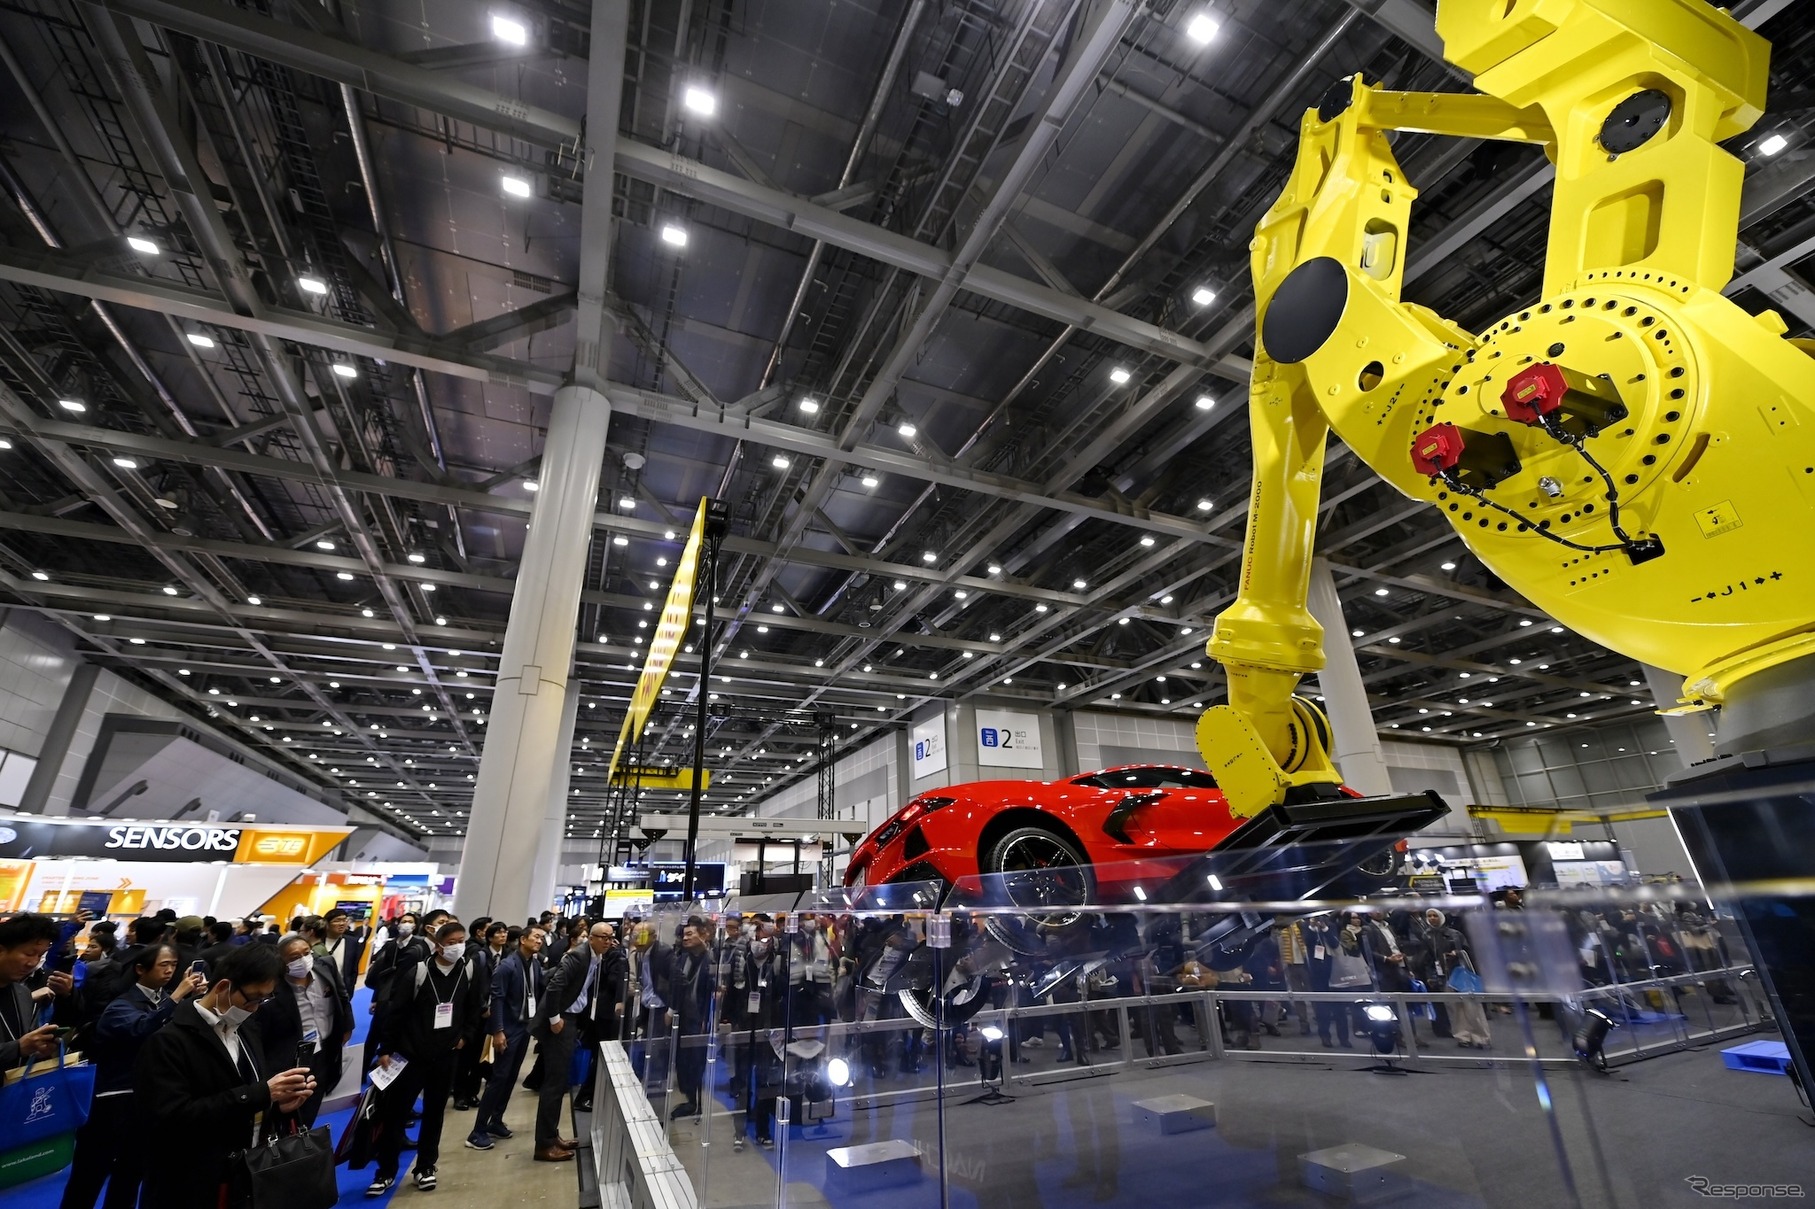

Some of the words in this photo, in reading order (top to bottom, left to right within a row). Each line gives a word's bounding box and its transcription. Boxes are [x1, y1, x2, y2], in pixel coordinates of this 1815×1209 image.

[1244, 556, 1253, 591] FANUC
[1249, 525, 1257, 554] Robot
[925, 738, 931, 757] 2
[1001, 729, 1013, 749] 2
[104, 826, 240, 851] SENSORS
